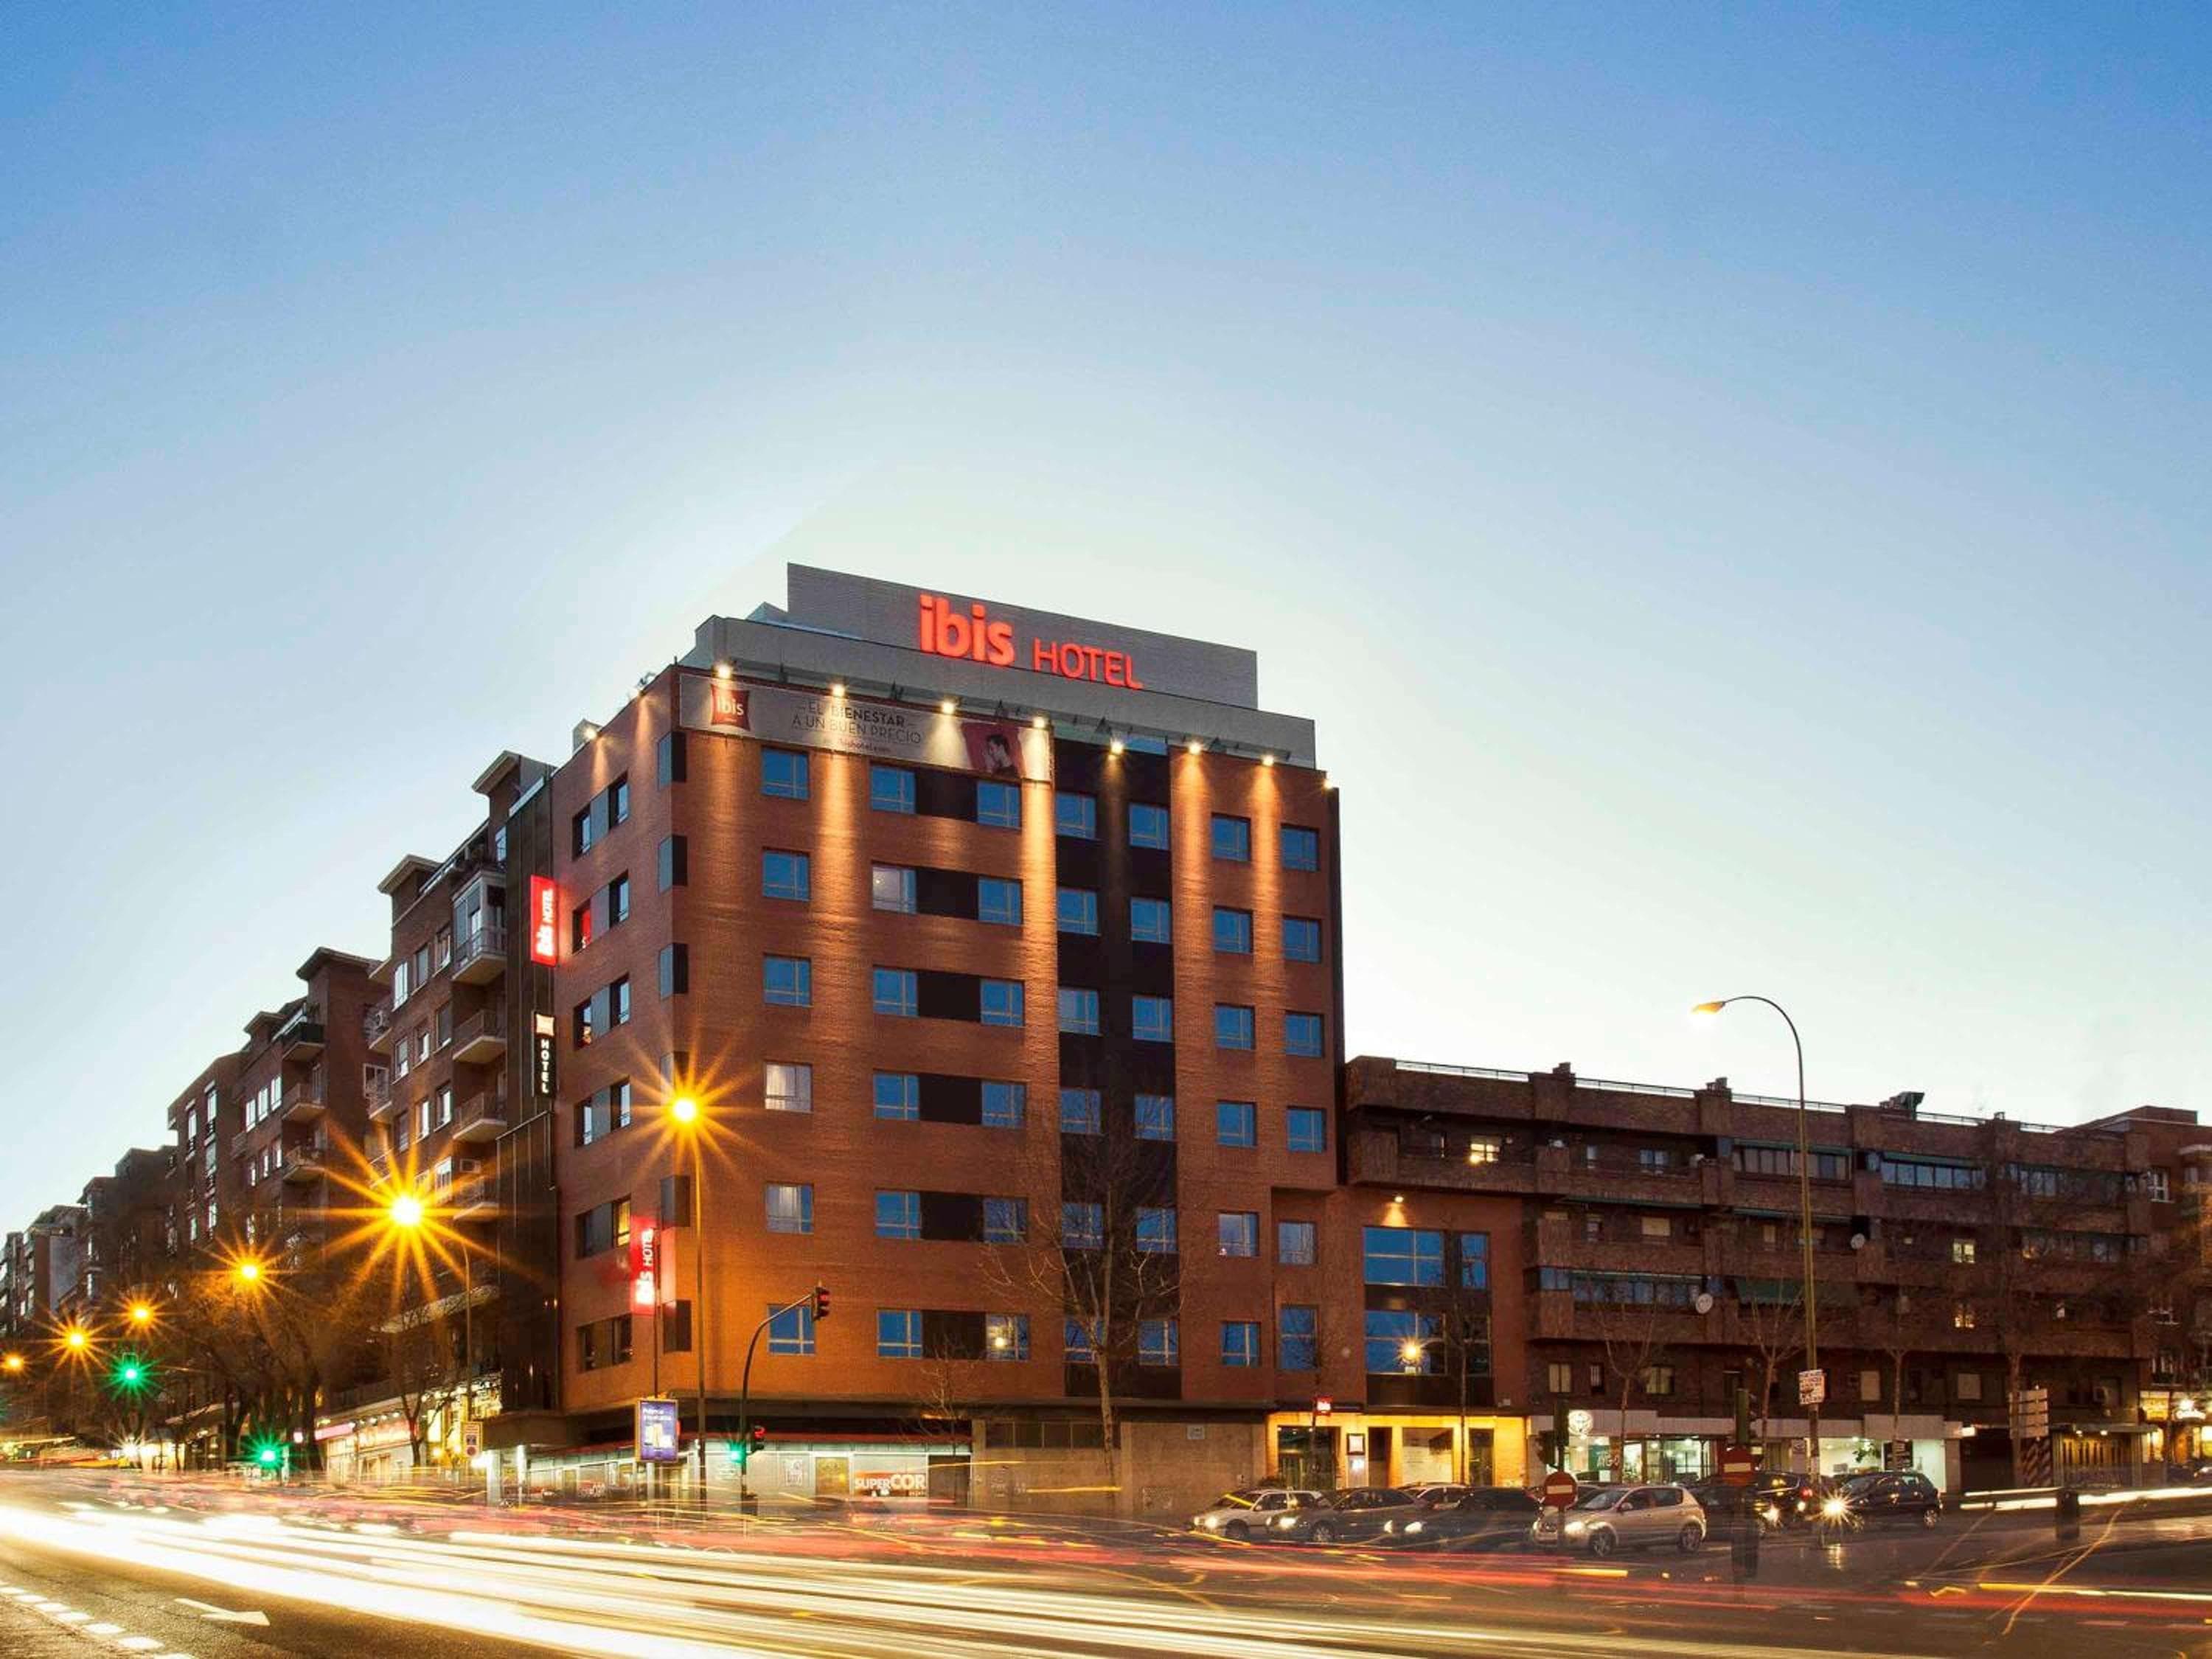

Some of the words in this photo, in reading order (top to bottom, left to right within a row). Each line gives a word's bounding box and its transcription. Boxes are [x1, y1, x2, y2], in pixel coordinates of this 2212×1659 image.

[919, 594, 1015, 667] ibis
[1032, 636, 1143, 690] HOTEL
[792, 715, 801, 727] A
[806, 717, 825, 729] UN
[830, 719, 866, 737] BUEN
[870, 724, 922, 744] PRECIO
[831, 706, 905, 727] BIENESTAR
[540, 1038, 550, 1093] HOTEL
[855, 1474, 927, 1489] SUPERCOR
